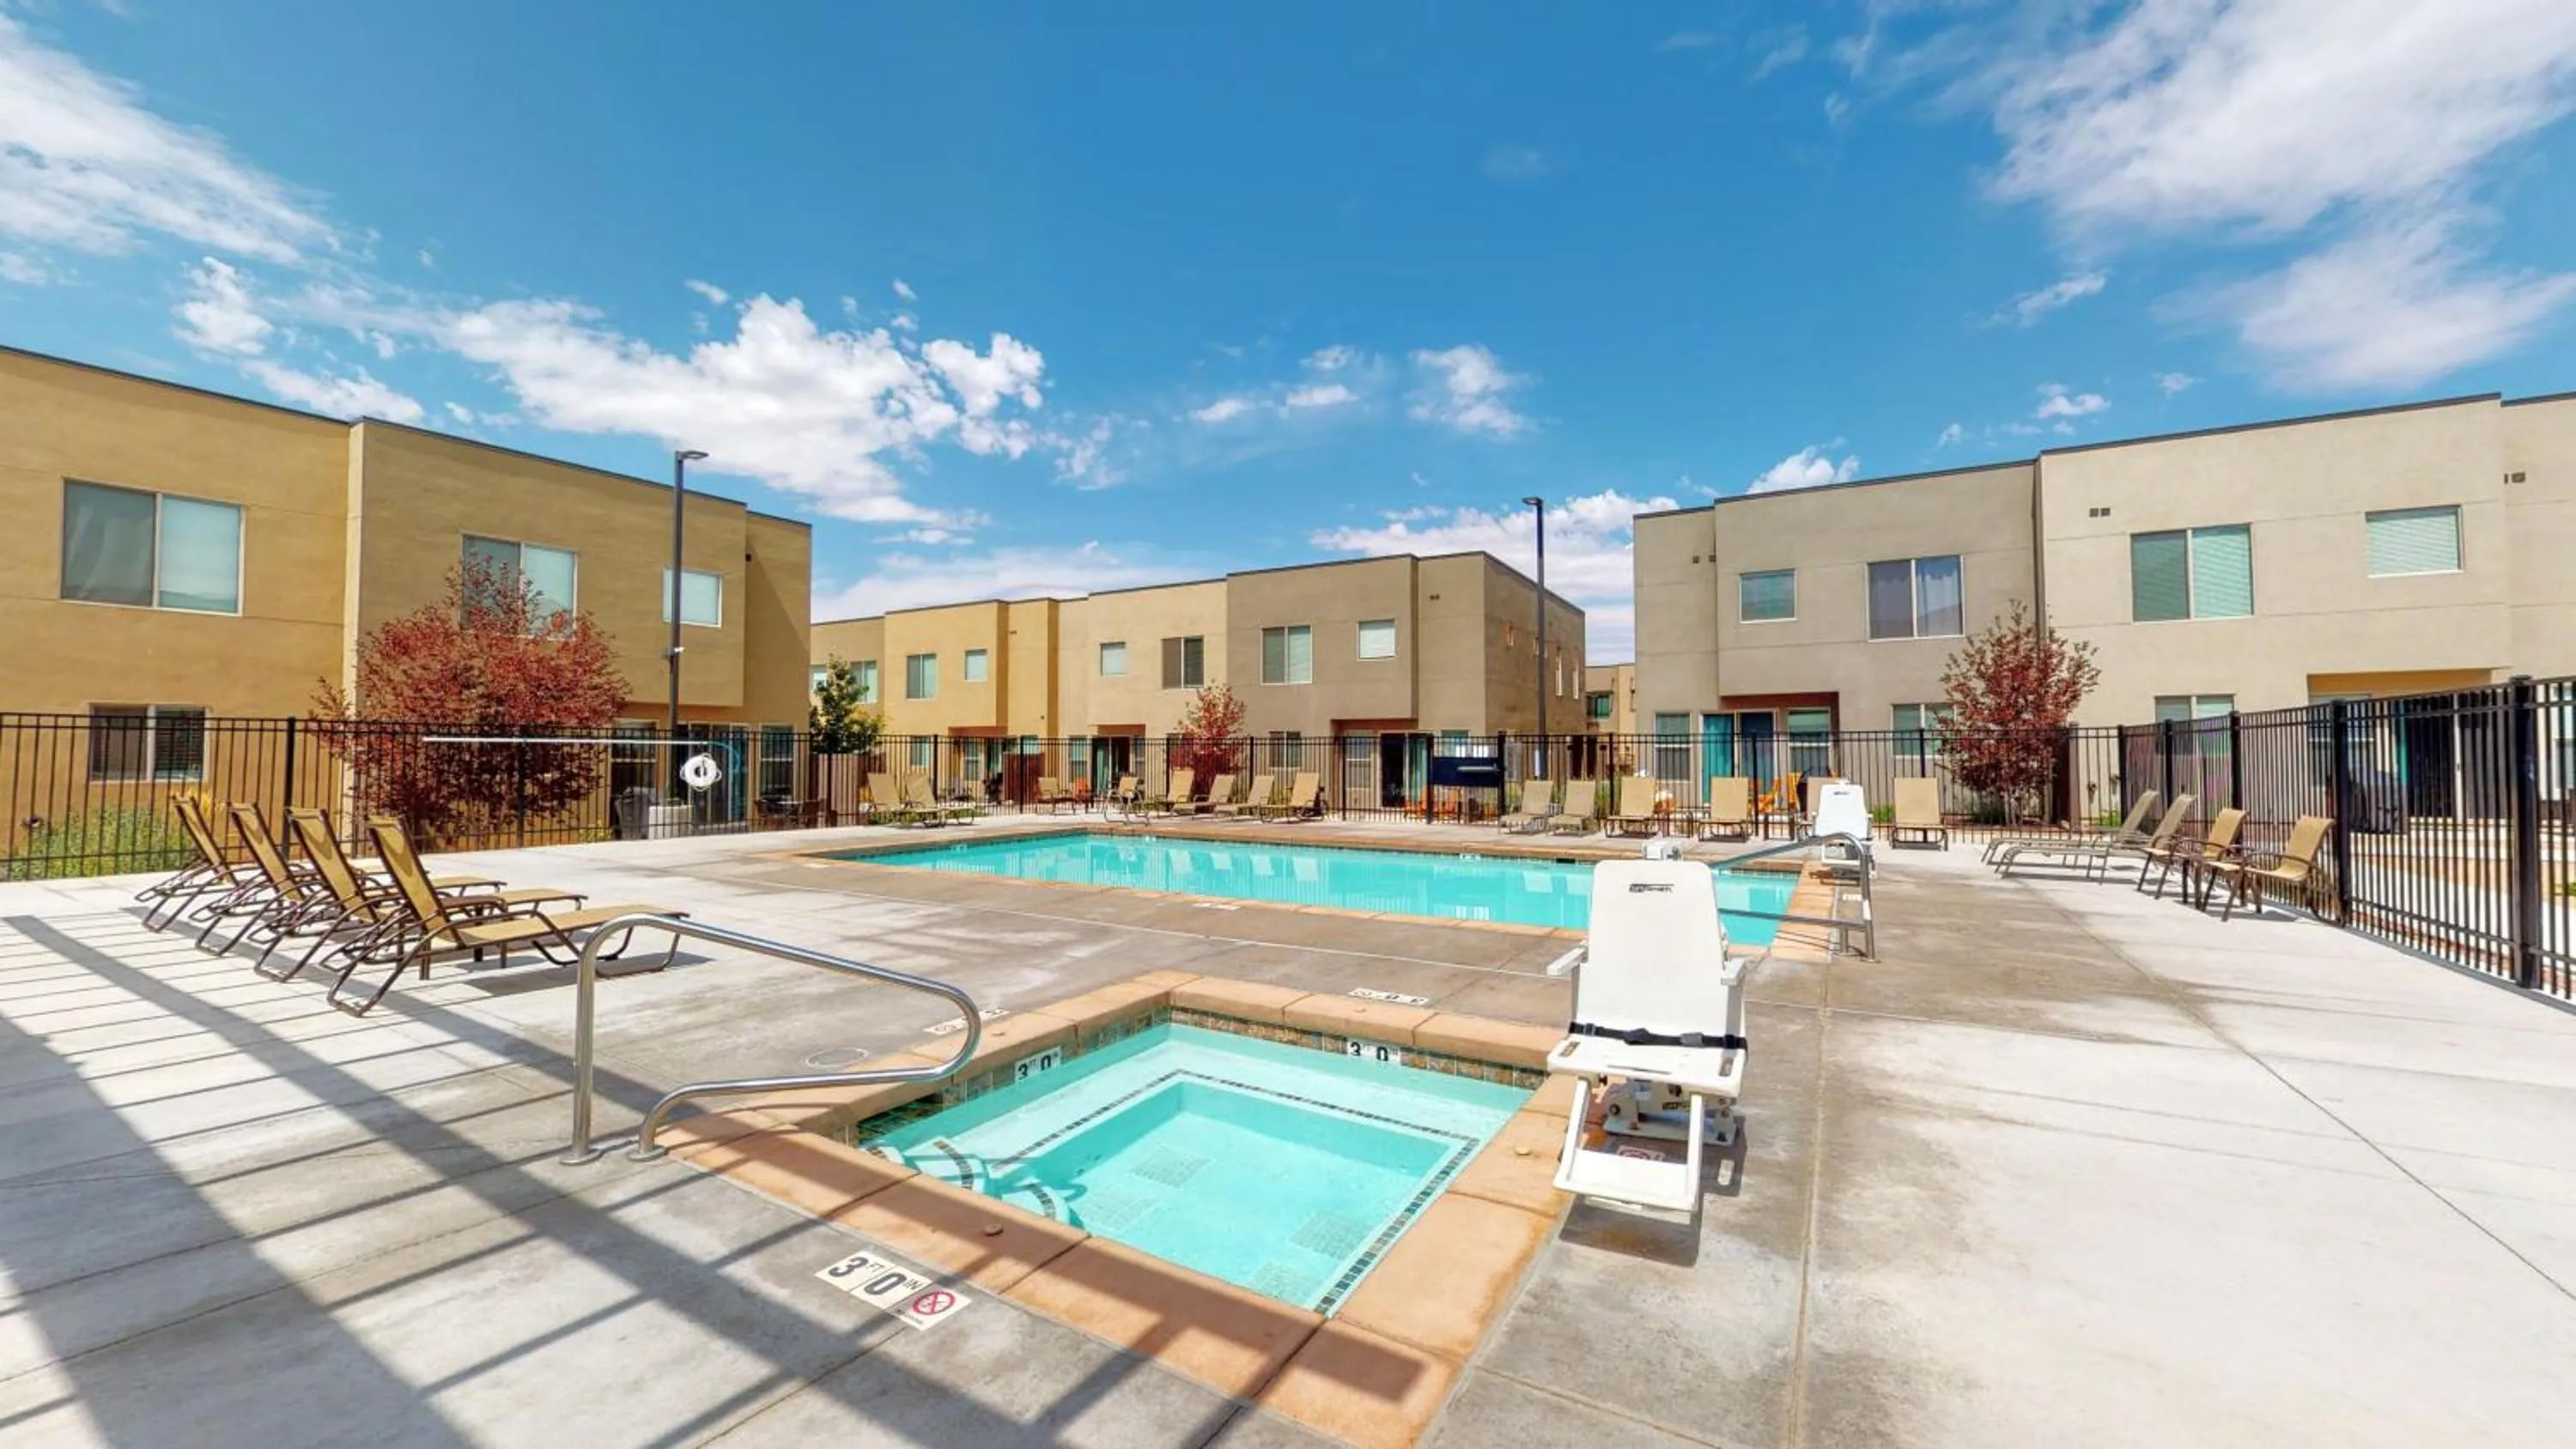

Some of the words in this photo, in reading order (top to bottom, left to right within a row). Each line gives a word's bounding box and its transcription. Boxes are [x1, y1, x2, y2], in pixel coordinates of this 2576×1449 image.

[1351, 1041, 1361, 1057] 3
[1376, 1046, 1388, 1061] 0
[1018, 1064, 1028, 1080] 3
[828, 1256, 869, 1277] 3
[864, 1272, 908, 1295] 0
